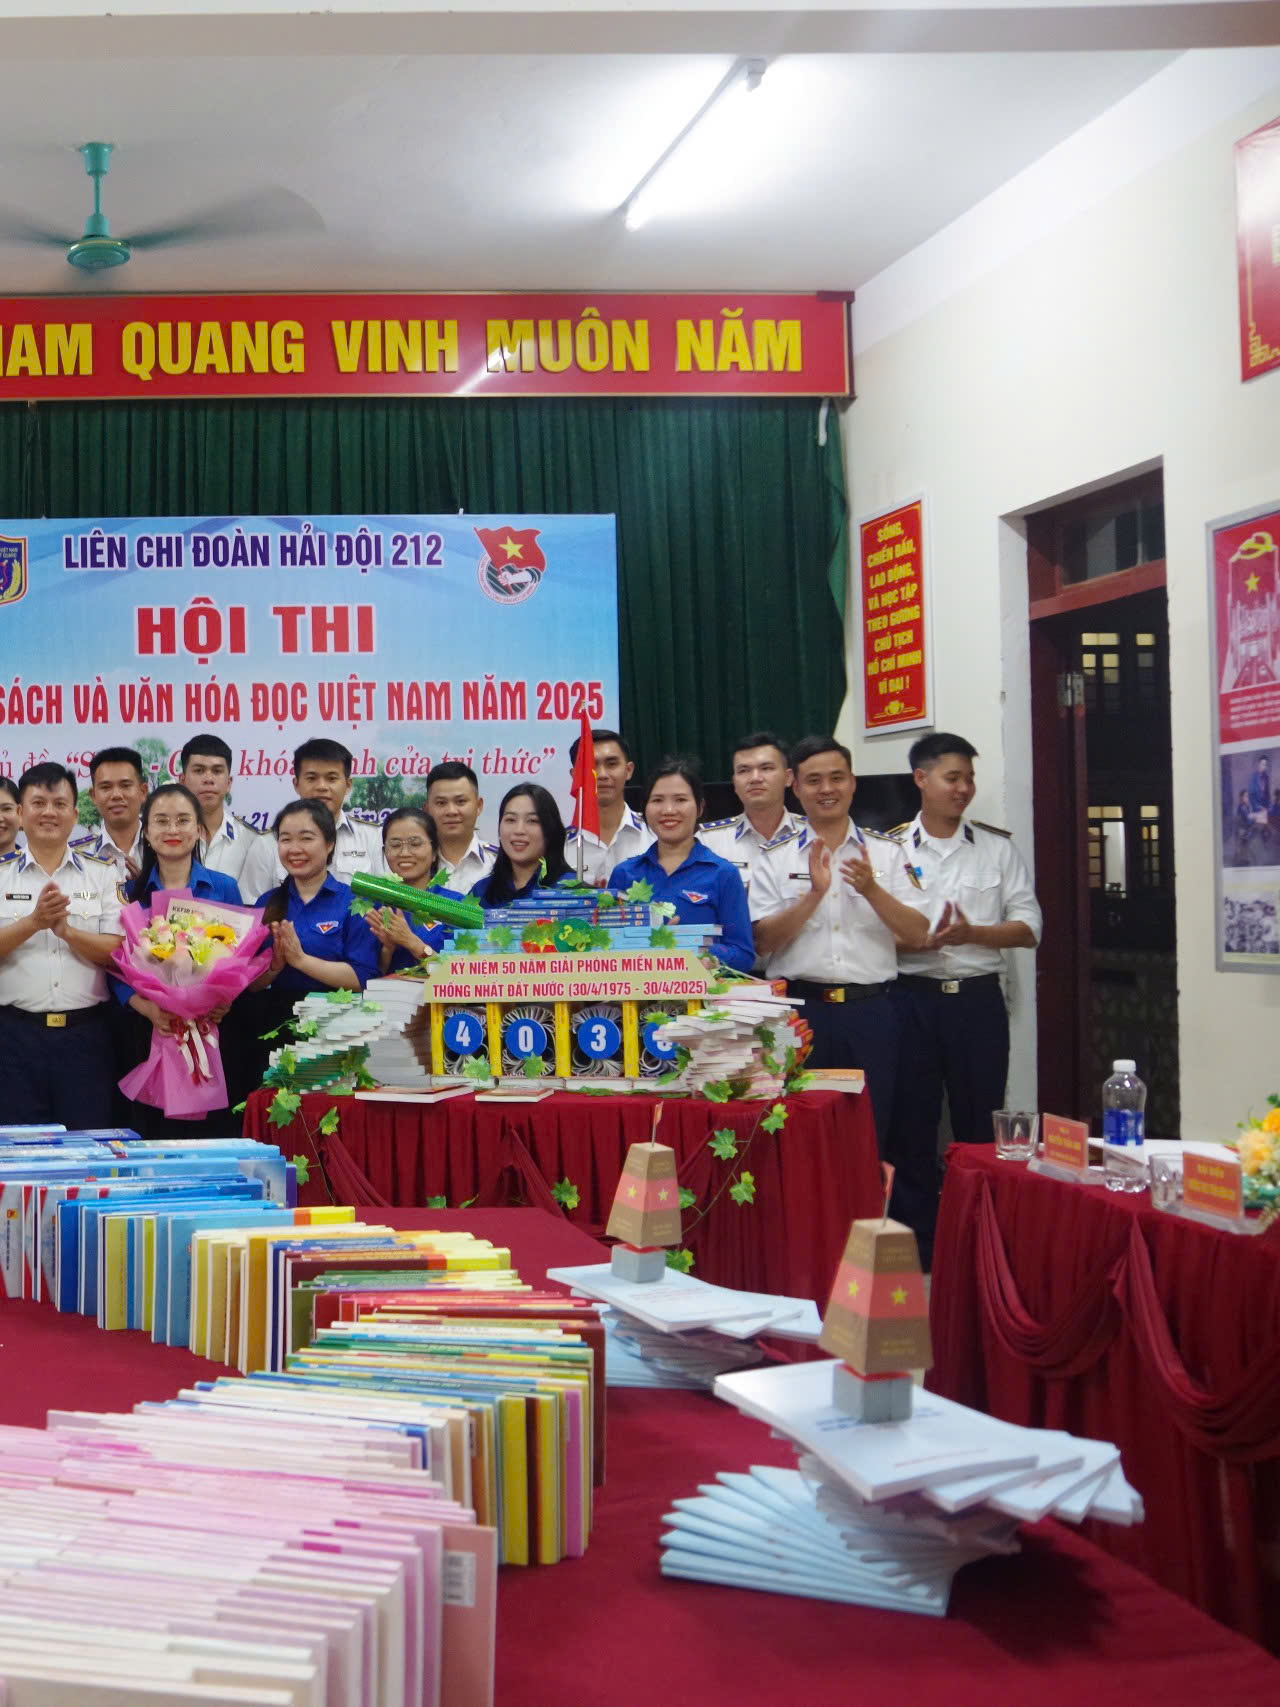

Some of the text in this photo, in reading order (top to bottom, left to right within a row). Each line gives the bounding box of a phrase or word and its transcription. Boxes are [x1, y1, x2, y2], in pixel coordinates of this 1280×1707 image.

[121, 320, 304, 380] QUANG
[331, 319, 458, 374] VINH
[486, 307, 649, 374] MUÔN
[676, 307, 802, 373] NĂM
[64, 523, 443, 573] LIÊN CHI ĐOÀN HẢI ĐỘI 212
[137, 597, 374, 664] HỘI THI
[867, 615, 888, 632] THEO
[74, 676, 109, 724] VÀ
[119, 676, 173, 723] VĂN
[185, 675, 240, 722] HÓA
[251, 682, 308, 731] ĐỌC
[318, 674, 376, 730] VIỆT
[387, 682, 452, 721] NAM
[462, 674, 526, 721] NĂM
[536, 682, 603, 721] 2025
[385, 745, 431, 775] cửa
[451, 958, 465, 975] KỶ
[469, 960, 498, 977] NIỆM
[502, 961, 515, 974] 50
[519, 959, 546, 974] NĂM
[550, 956, 573, 974] GIẢI
[577, 957, 617, 973] PHÓNG
[433, 980, 471, 998] THỐNG
[474, 980, 504, 998] NHẤT
[507, 979, 529, 997] ĐẤT
[532, 980, 564, 997] NƯỚC
[568, 982, 631, 998] (30/4/1975
[643, 980, 708, 996] 30/4/2025)
[455, 1020, 607, 1052] 4 0 3
